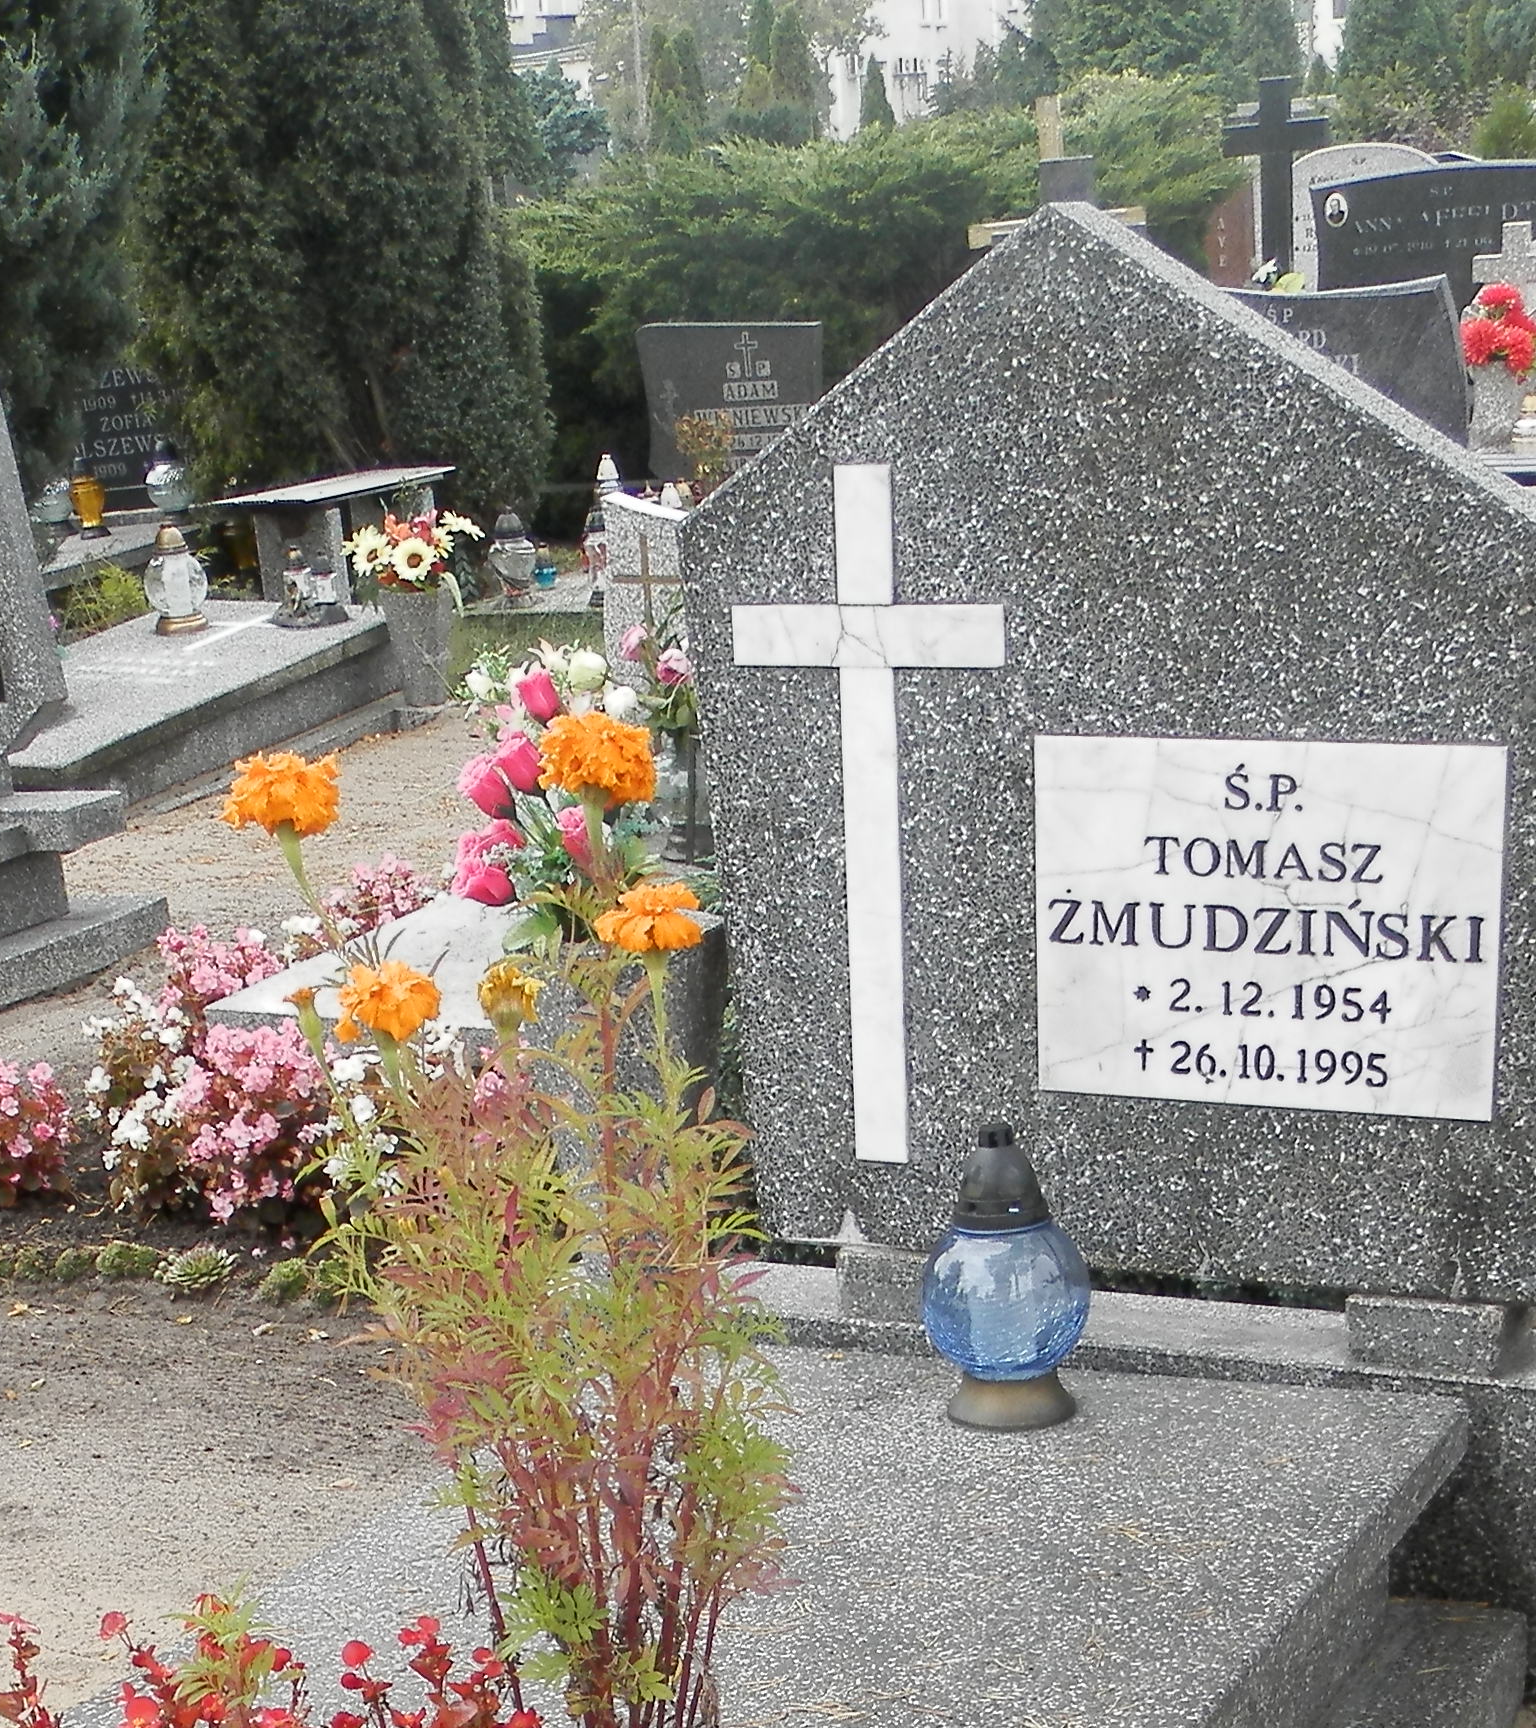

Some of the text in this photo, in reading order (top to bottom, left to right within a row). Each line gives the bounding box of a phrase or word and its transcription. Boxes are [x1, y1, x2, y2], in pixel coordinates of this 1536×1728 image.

[725, 382, 776, 399] ADAM
[1223, 763, 1304, 812] Ś.P.
[1143, 836, 1384, 884] TOMASZ
[1047, 888, 1487, 964] ŻMUDZIŃSKI
